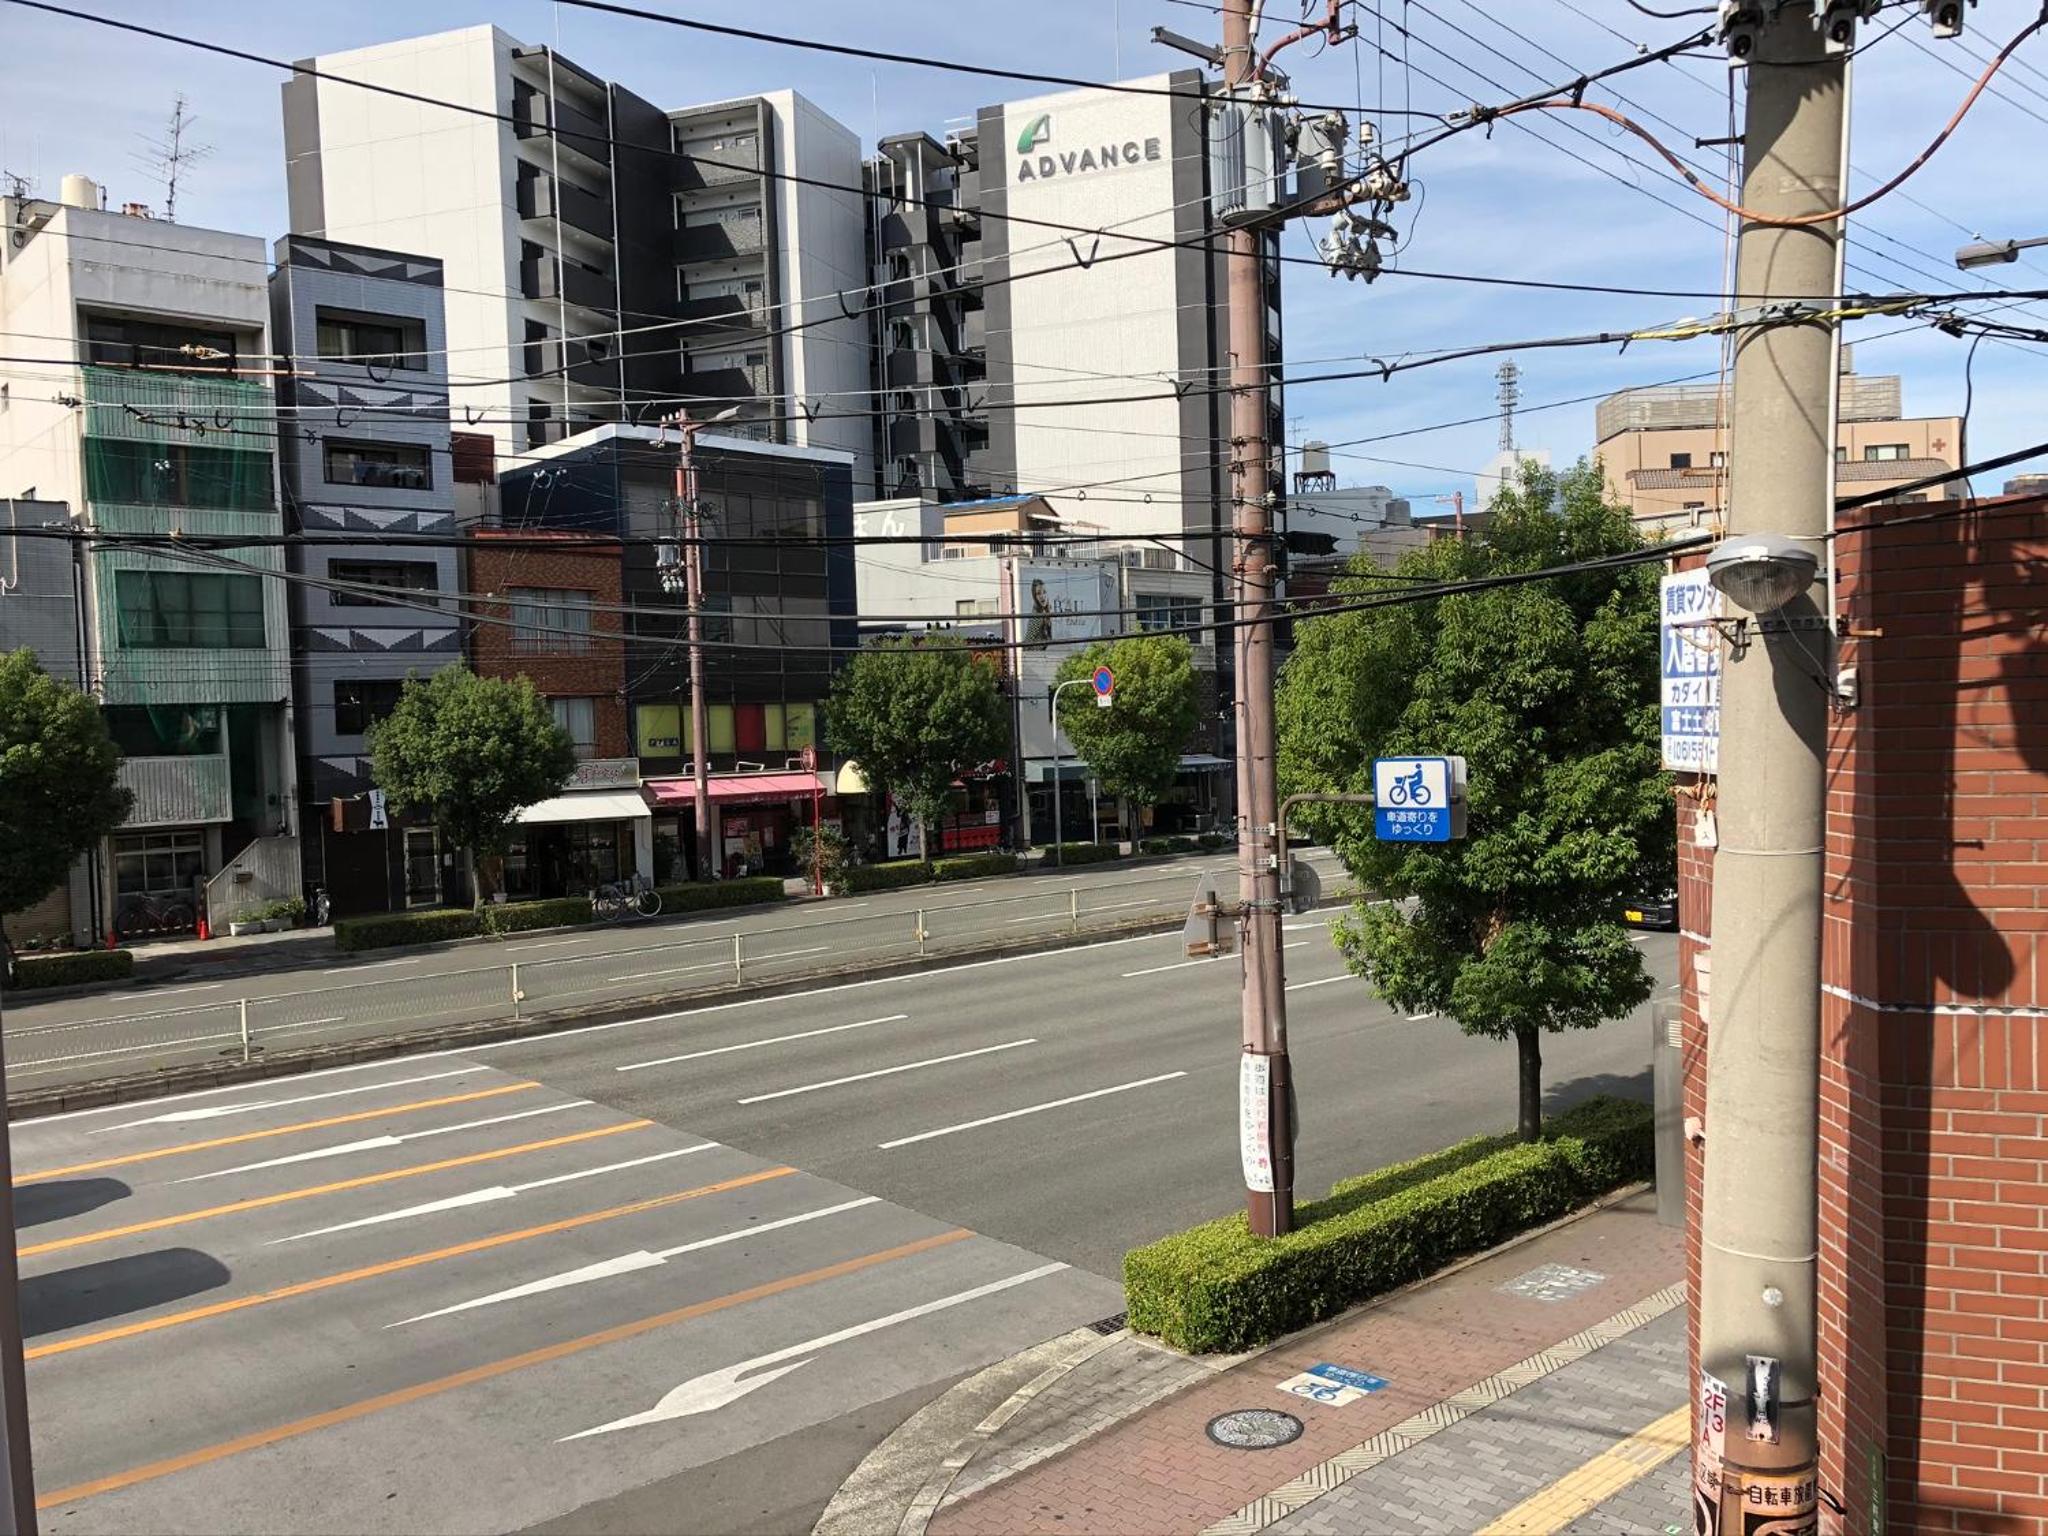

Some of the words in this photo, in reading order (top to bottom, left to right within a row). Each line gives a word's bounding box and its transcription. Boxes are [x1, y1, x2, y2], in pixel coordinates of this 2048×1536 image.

[1018, 137, 1162, 183] ADVANCE
[1386, 811, 1438, 823] 車道寄りを
[1391, 823, 1434, 835] ゆっくり
